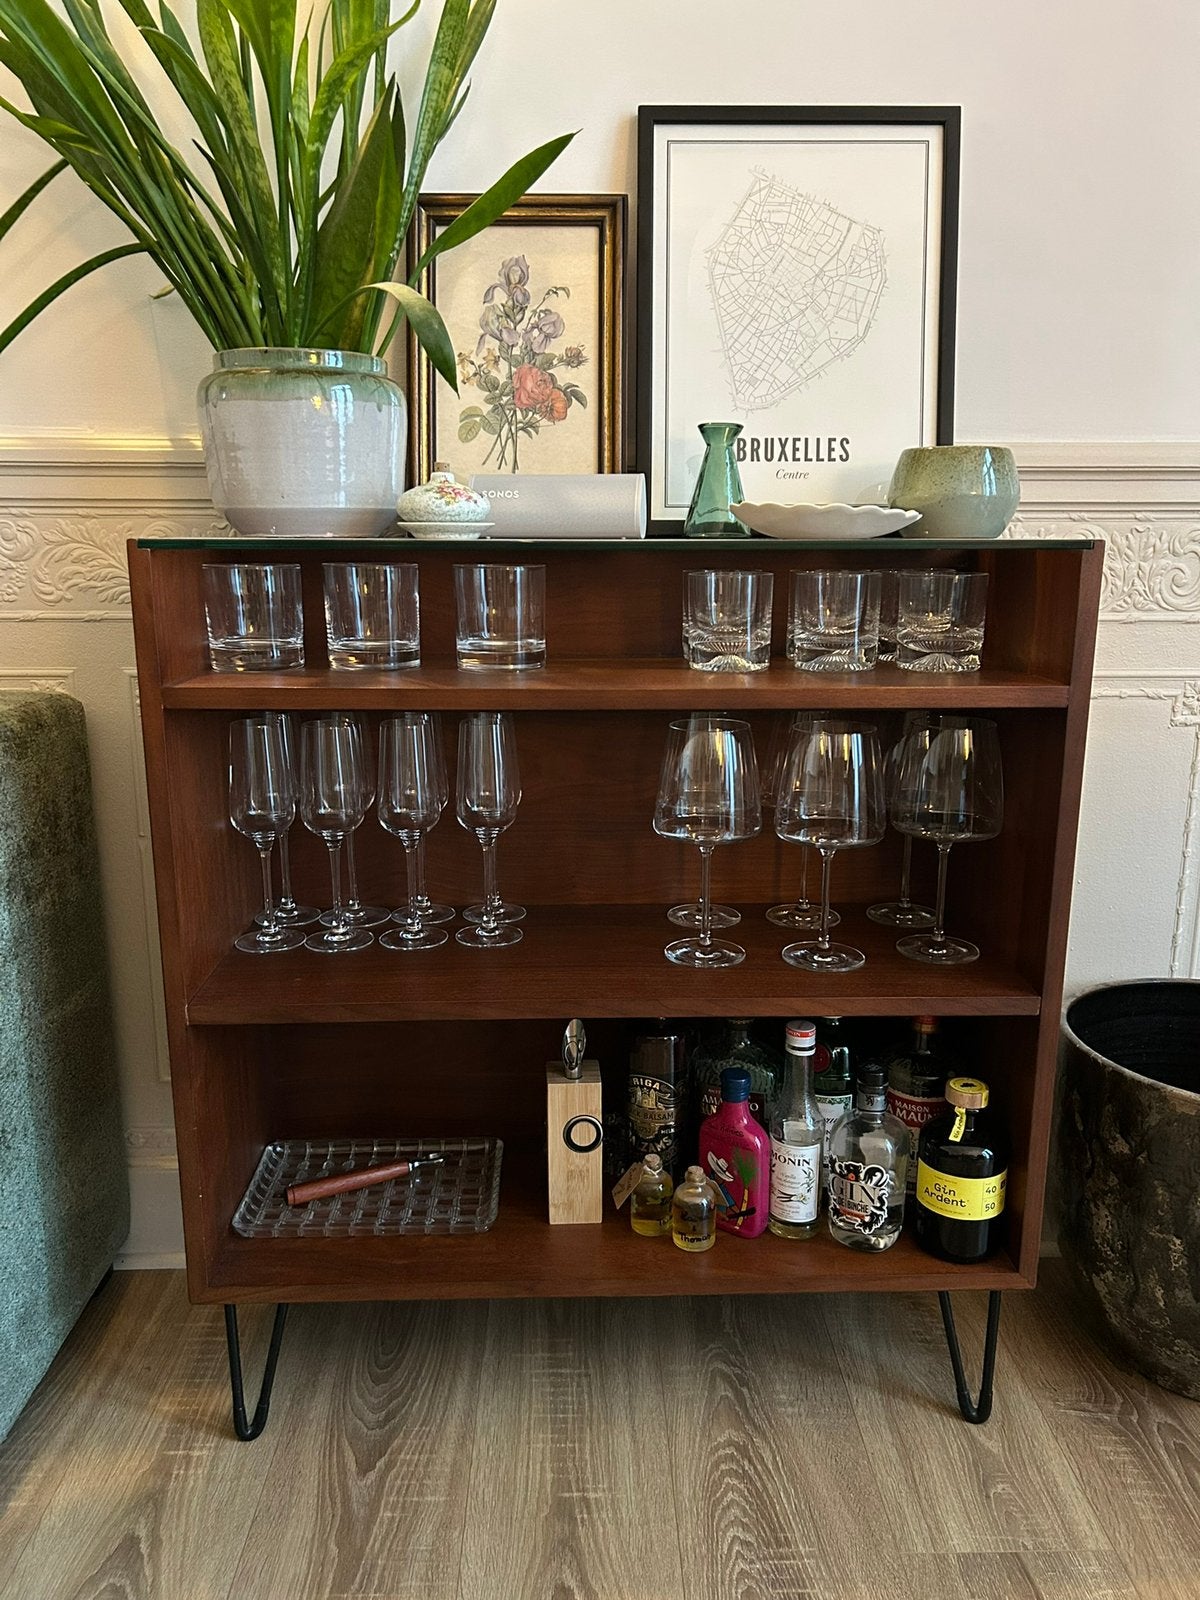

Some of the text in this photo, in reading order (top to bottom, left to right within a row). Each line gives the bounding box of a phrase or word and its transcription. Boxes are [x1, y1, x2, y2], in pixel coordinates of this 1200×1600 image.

[736, 437, 850, 462] BRUXELLES
[775, 468, 810, 480] Centre
[482, 490, 520, 499] SONOS
[632, 1077, 660, 1090] RIGA
[895, 1099, 930, 1113] MAISON
[643, 1111, 674, 1121] BALSAM
[771, 1149, 811, 1167] MONIN
[832, 1175, 878, 1205] GIN
[934, 1182, 956, 1197] Gin
[985, 1185, 997, 1195] 40
[924, 1187, 967, 1208] Ardent
[985, 1202, 996, 1212] 50
